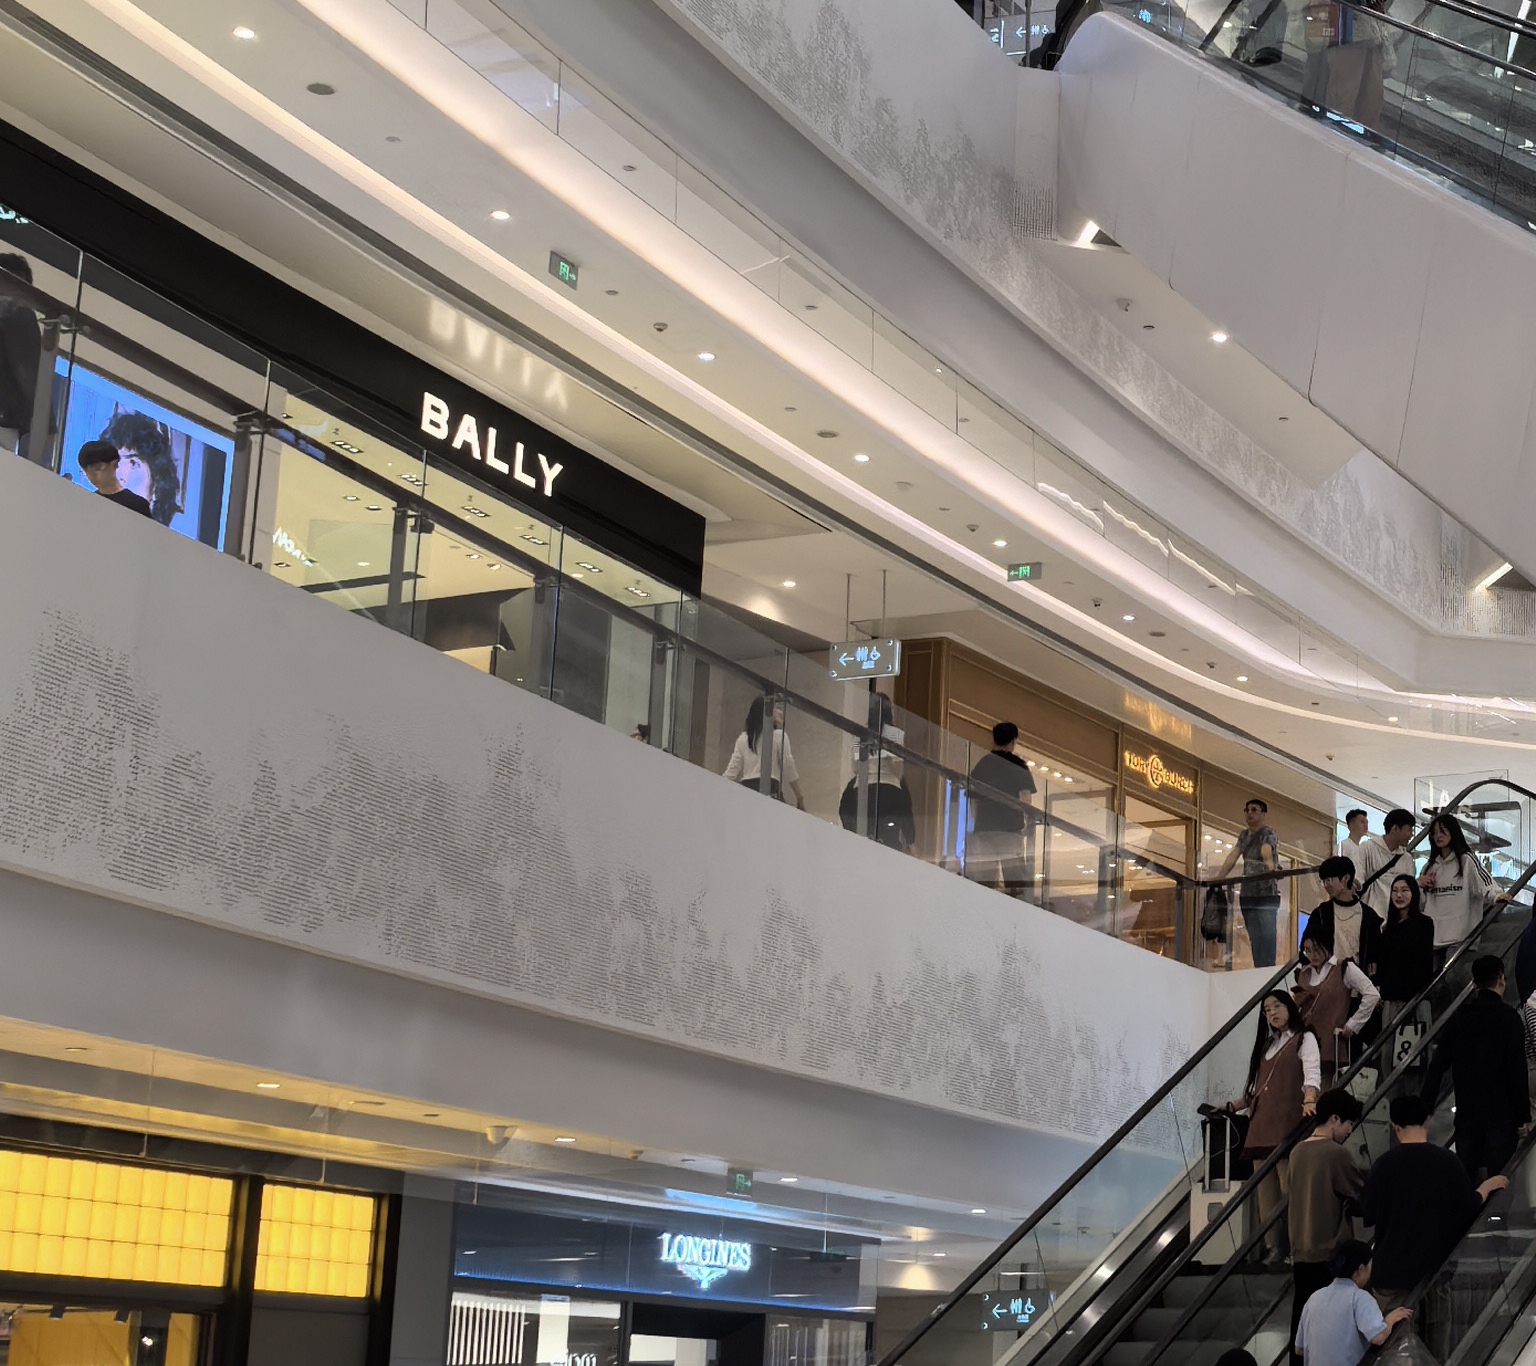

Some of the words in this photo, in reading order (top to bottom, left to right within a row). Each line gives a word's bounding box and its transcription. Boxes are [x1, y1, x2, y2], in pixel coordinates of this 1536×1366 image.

[420, 391, 564, 497] BALLY
[1124, 750, 1149, 774] TORY
[1162, 769, 1194, 795] BURCH
[659, 1232, 752, 1272] LONGINES
